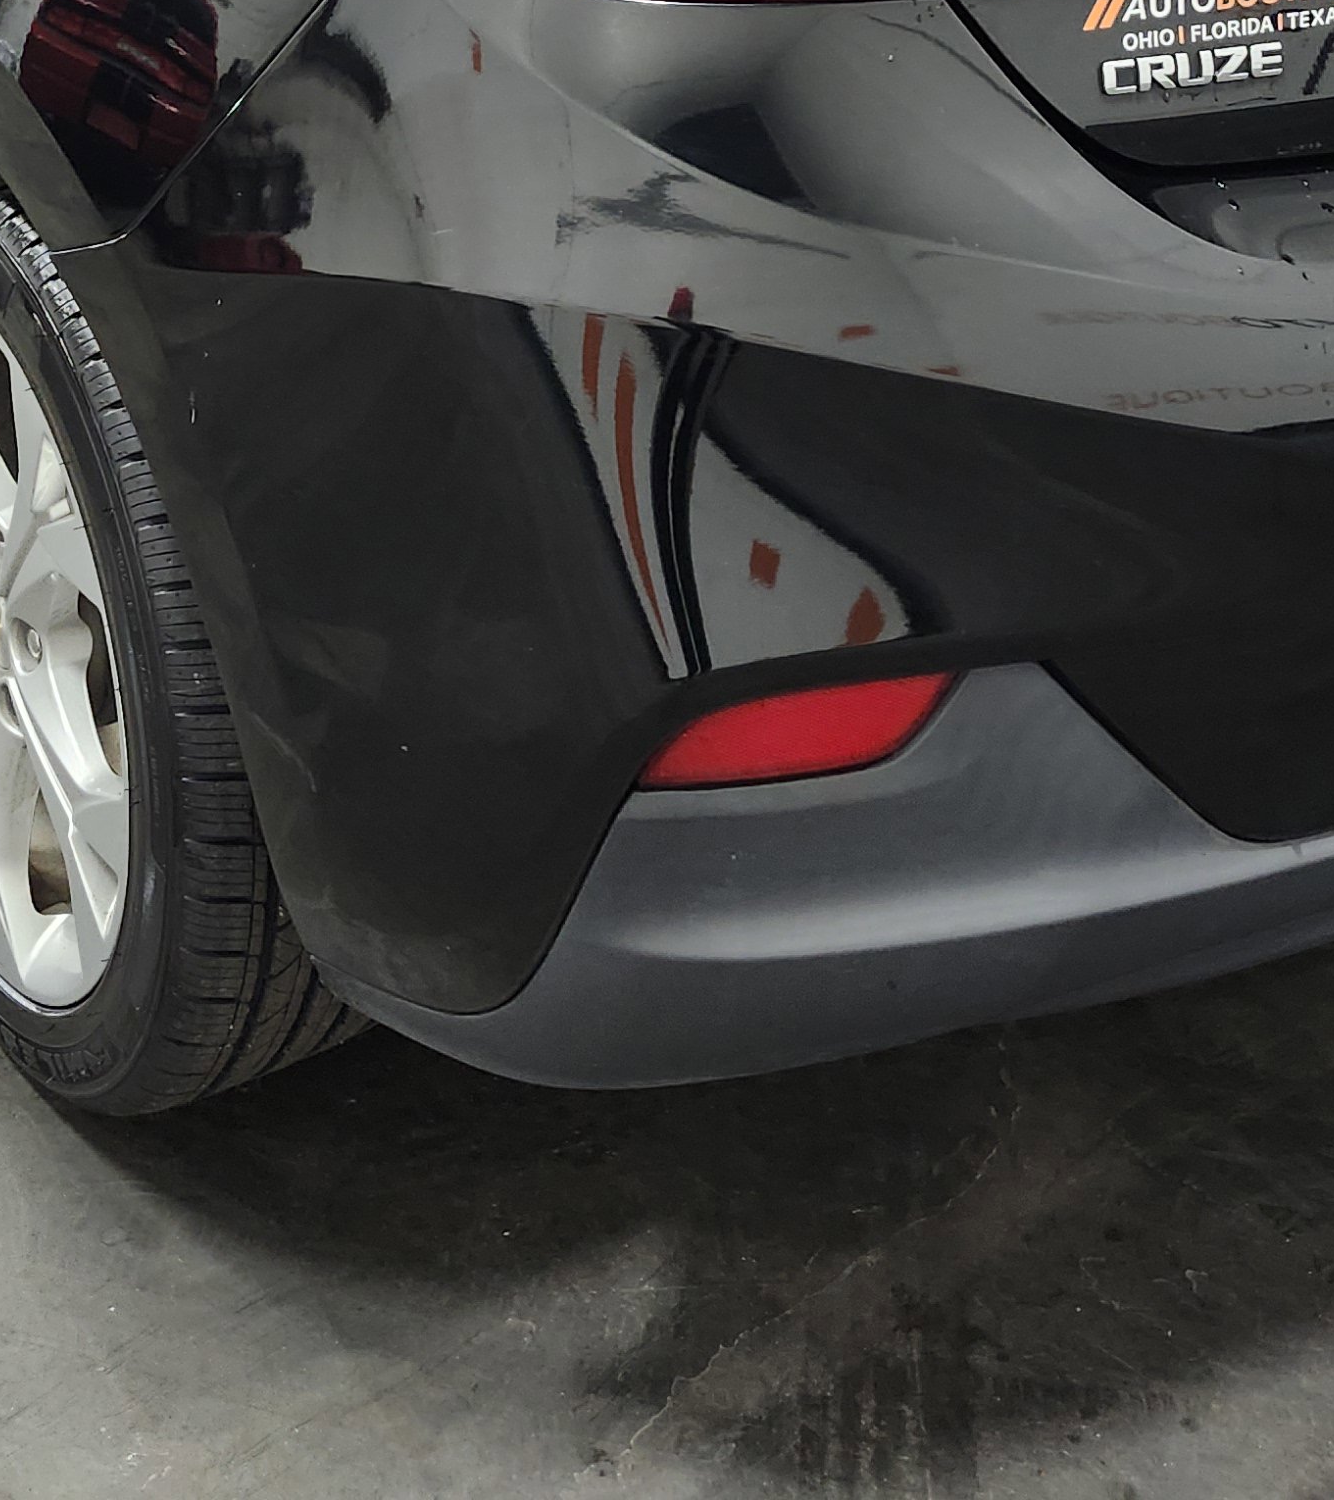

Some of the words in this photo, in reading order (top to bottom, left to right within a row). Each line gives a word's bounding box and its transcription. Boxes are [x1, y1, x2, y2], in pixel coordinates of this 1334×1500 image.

[1122, 28, 1176, 51] OHIO
[1189, 15, 1275, 43] FLORIDA
[1100, 41, 1283, 95] CRUZE
